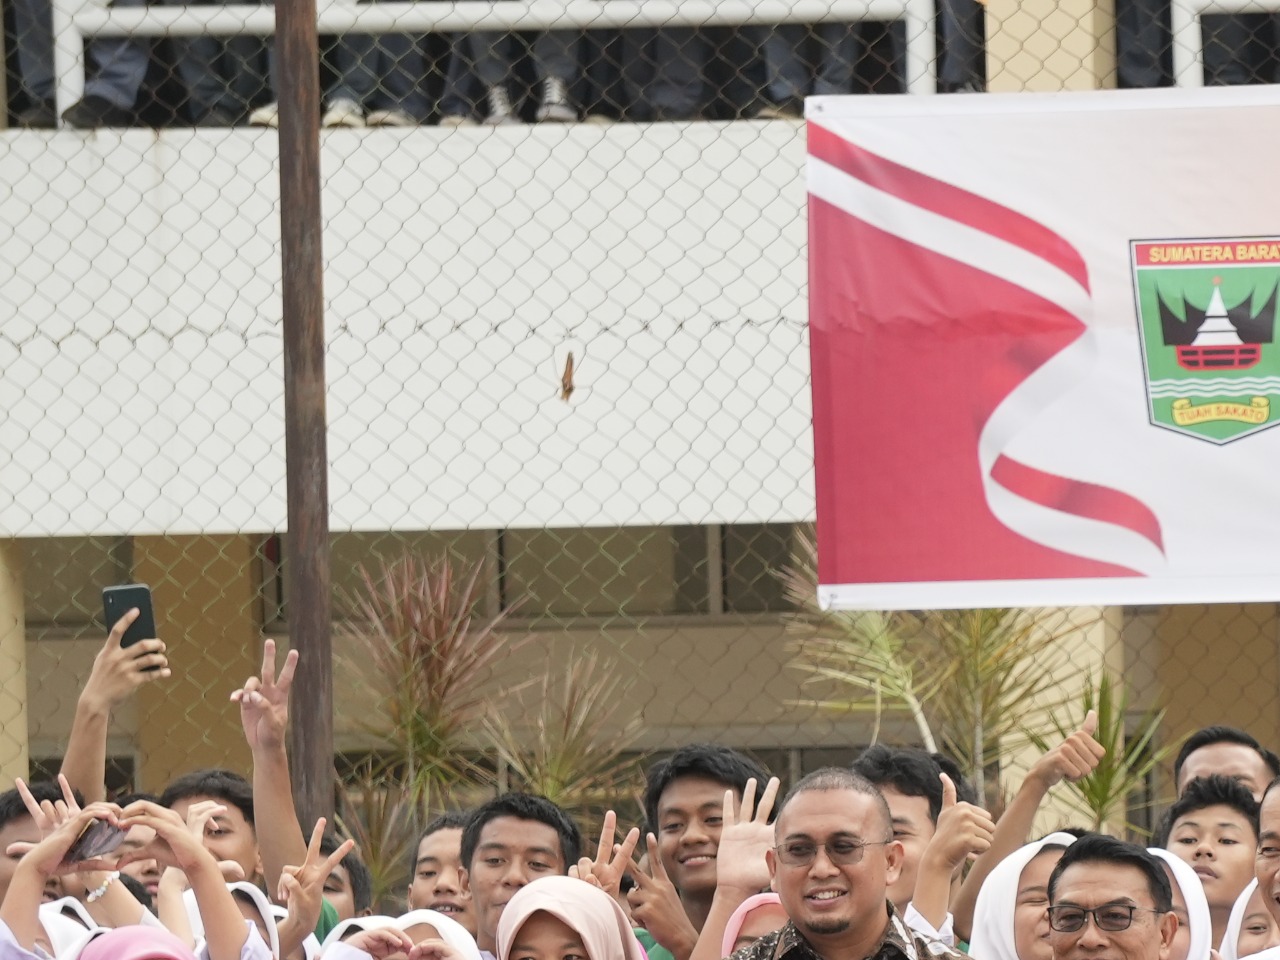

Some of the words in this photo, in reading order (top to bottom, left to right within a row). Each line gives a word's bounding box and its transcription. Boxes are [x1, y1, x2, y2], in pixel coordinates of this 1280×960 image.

[1149, 245, 1234, 262] SUMATERA
[1179, 406, 1212, 424] TUAH
[1216, 404, 1265, 422] SAKATO
